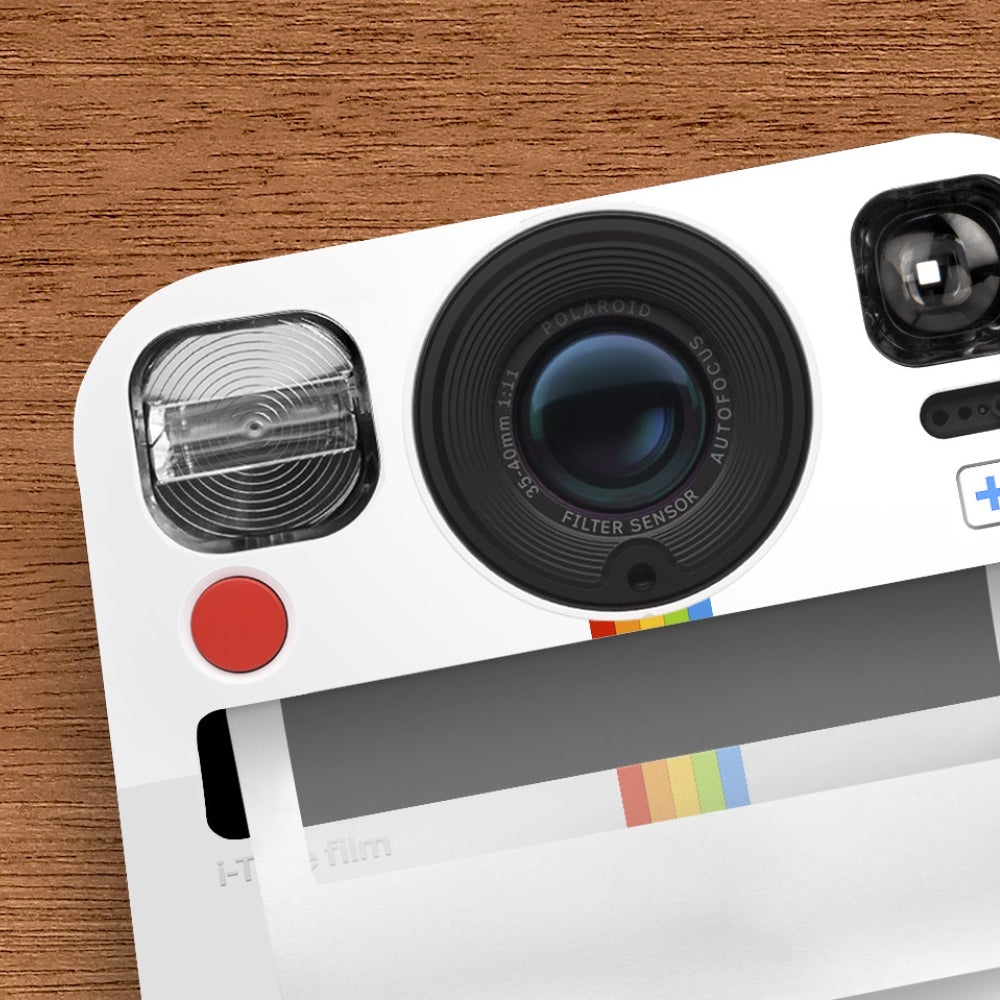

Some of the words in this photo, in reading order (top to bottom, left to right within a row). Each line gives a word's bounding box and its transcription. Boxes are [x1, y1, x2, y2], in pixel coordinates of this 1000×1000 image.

[540, 299, 652, 335] POLAROID
[498, 369, 519, 407] 1:11
[689, 336, 732, 464] AUTOFOCUS
[500, 415, 539, 498] 35-40mm
[561, 510, 623, 534] FILTER
[630, 489, 699, 532] SENSOR
[324, 835, 393, 867] film
